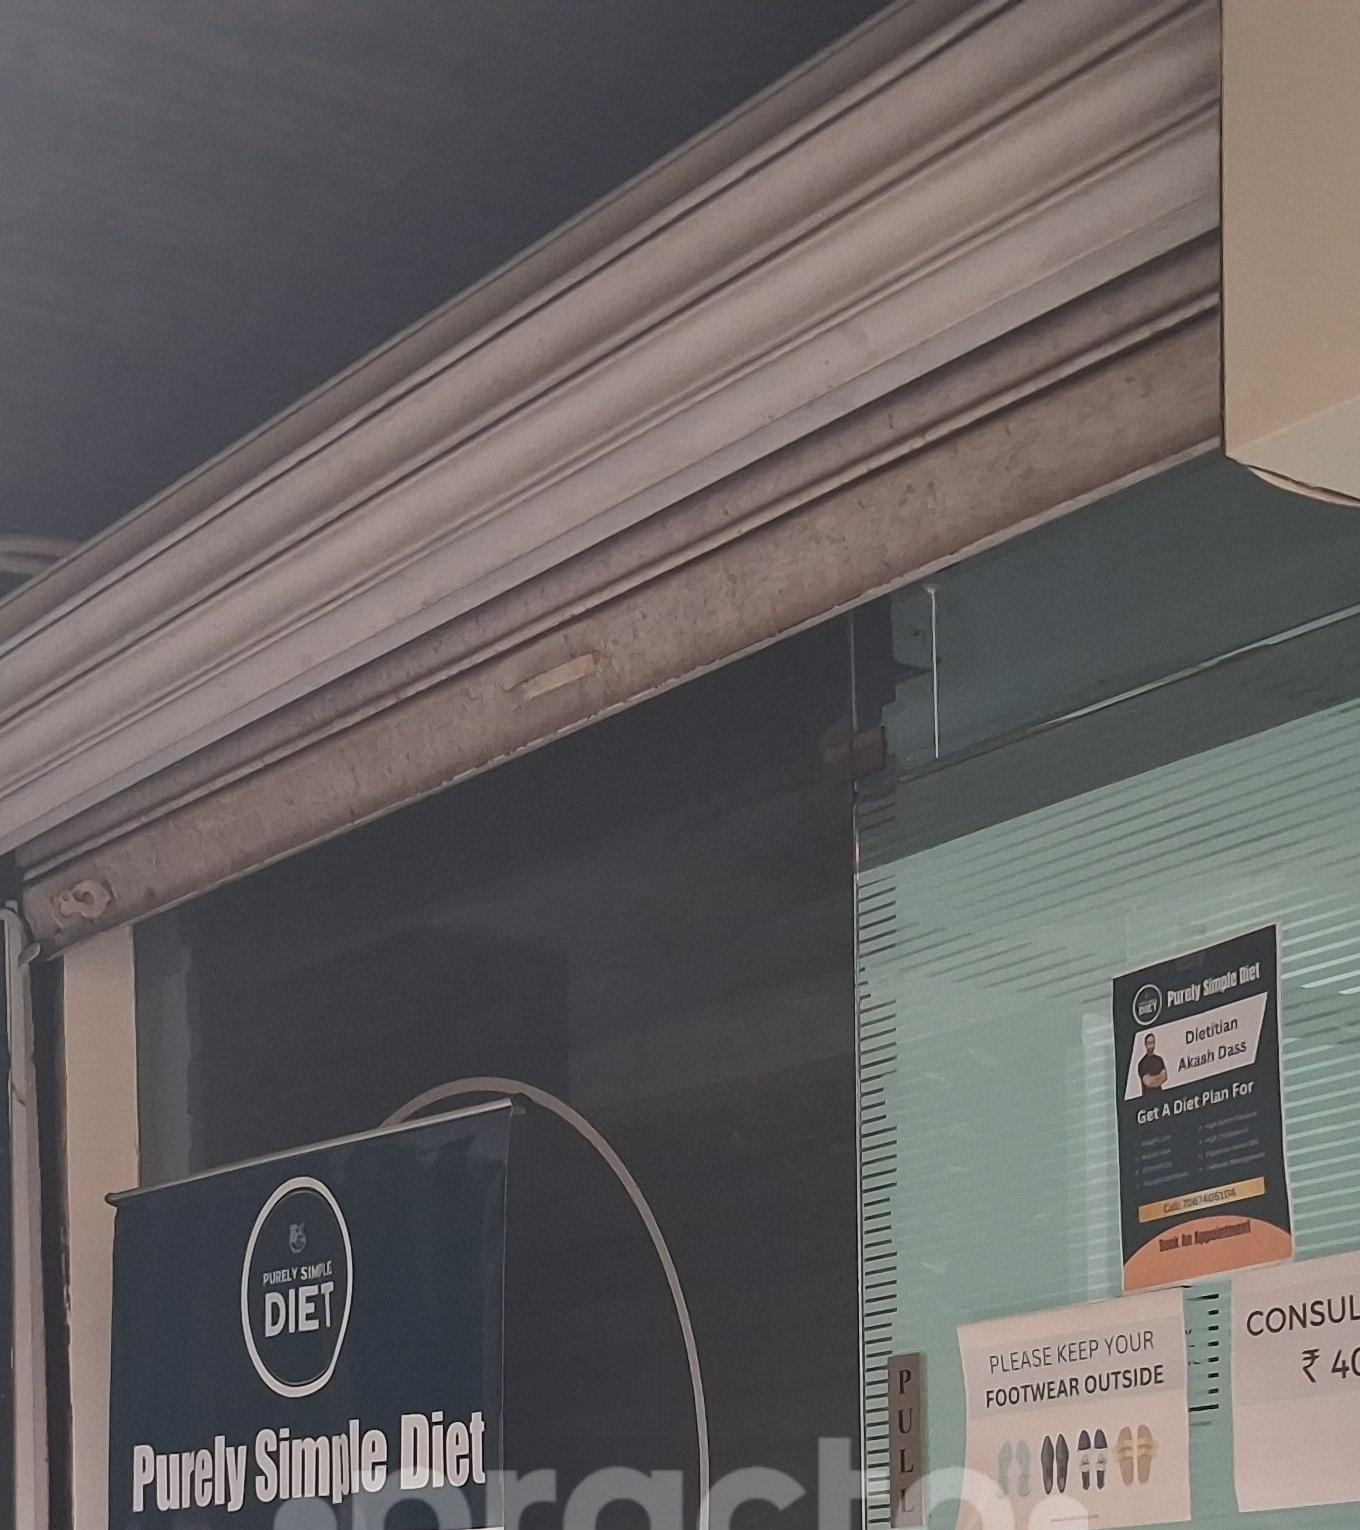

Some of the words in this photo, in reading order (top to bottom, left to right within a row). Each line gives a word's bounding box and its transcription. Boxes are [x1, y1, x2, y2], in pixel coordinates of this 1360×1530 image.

[1178, 1048, 1215, 1073] Akash
[1218, 1041, 1248, 1061] Dass
[1137, 1106, 1159, 1125] Get
[1161, 1102, 1172, 1117] A
[1174, 1096, 1200, 1114] Diet
[1202, 1088, 1229, 1107] Plan
[1232, 1080, 1255, 1098] For
[262, 1266, 299, 1286] PURELY
[300, 1259, 333, 1281] SIMPLE
[264, 1281, 335, 1338] DIET
[988, 1348, 1053, 1375] PLEASE
[1056, 1339, 1100, 1367] KEEP
[1104, 1329, 1155, 1358] YOUR
[985, 1378, 1080, 1410] FOOTWEAR
[1084, 1364, 1164, 1395] OUTSIDE
[132, 1435, 248, 1514] Purely
[254, 1418, 388, 1505] Simple
[399, 1410, 487, 1492] Diet
[897, 1368, 915, 1514] PULL
